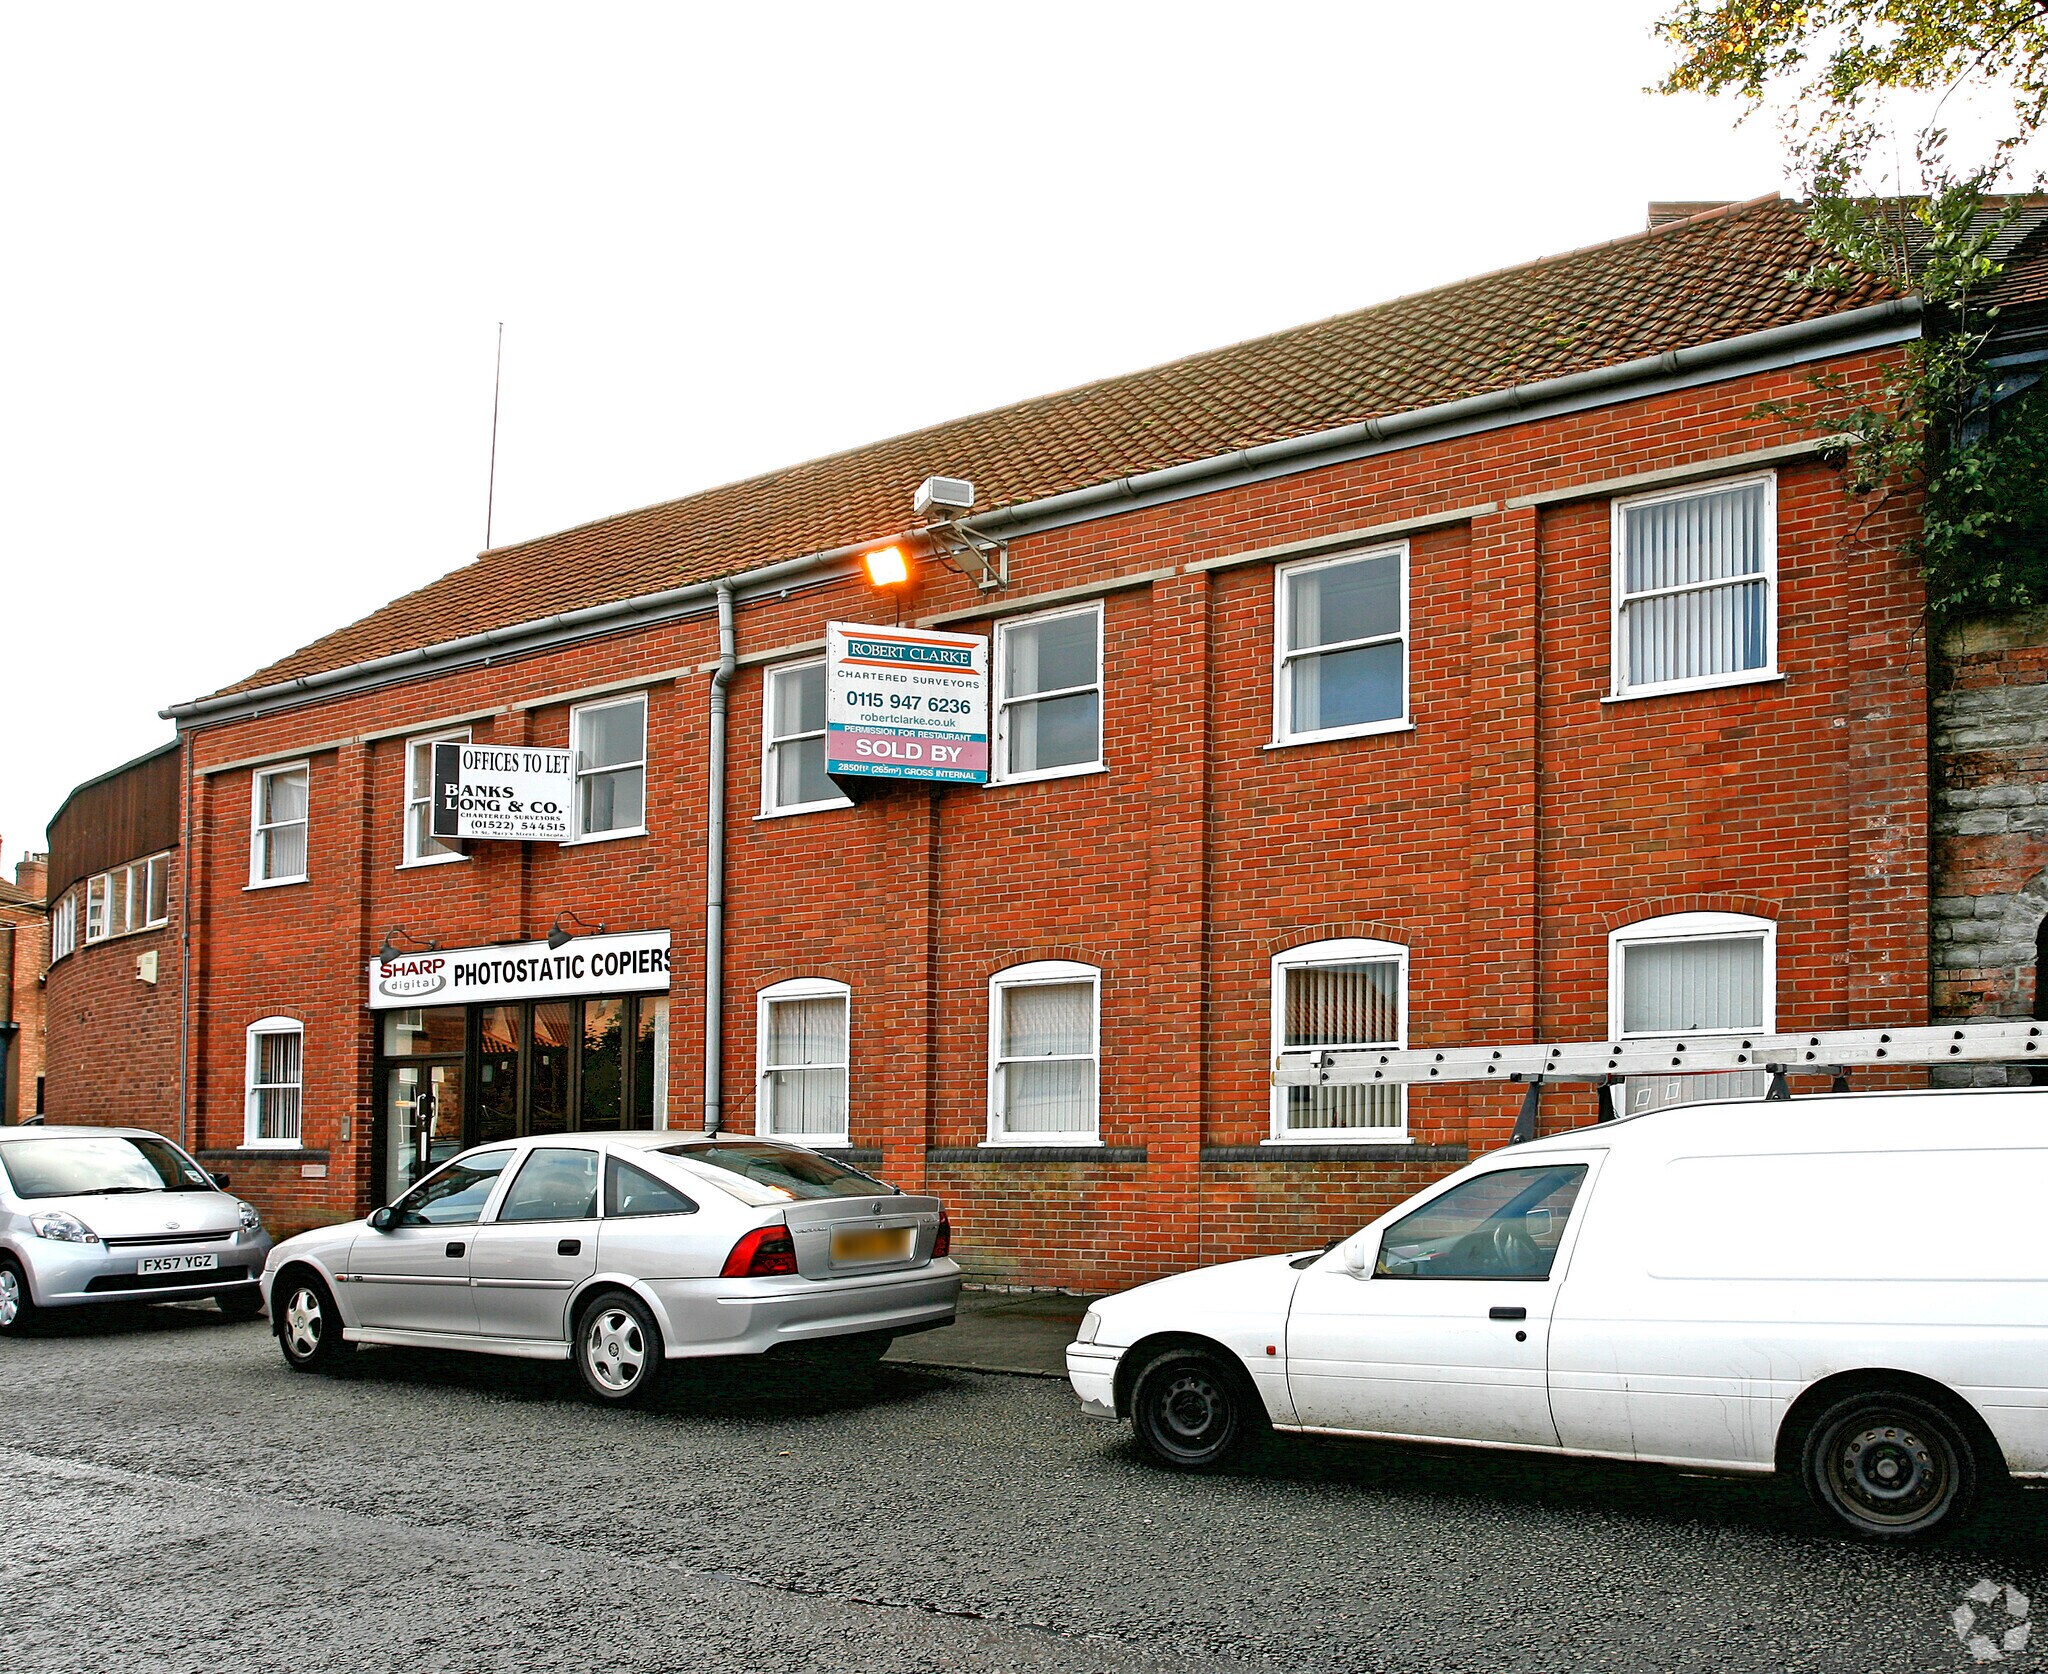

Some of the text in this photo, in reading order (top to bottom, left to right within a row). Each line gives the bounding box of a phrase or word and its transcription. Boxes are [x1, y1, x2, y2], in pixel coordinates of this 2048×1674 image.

[851, 642, 969, 664] ROBERT CLARKE
[837, 670, 980, 689] CHARTERED SURVEYORS
[846, 691, 971, 714] 0115 947 6236
[860, 712, 956, 727] robertclarke.co.uk
[844, 726, 972, 741] PERMISSION FOR RESTAURANT
[855, 739, 963, 763] SOLD BY
[463, 750, 570, 774] OFFICES TO LET
[904, 768, 935, 777] GROSS
[936, 770, 977, 780] INTERNAL
[444, 783, 514, 798] BANKS
[445, 797, 563, 814] LONG & CO.
[460, 812, 511, 820] CHARTERED
[471, 820, 566, 831] (01522) 544515
[380, 958, 445, 980] SHARP
[454, 955, 585, 987] PHOTOSTATIC
[391, 977, 437, 991] digital
[144, 1255, 212, 1272] FX57 YGZ
